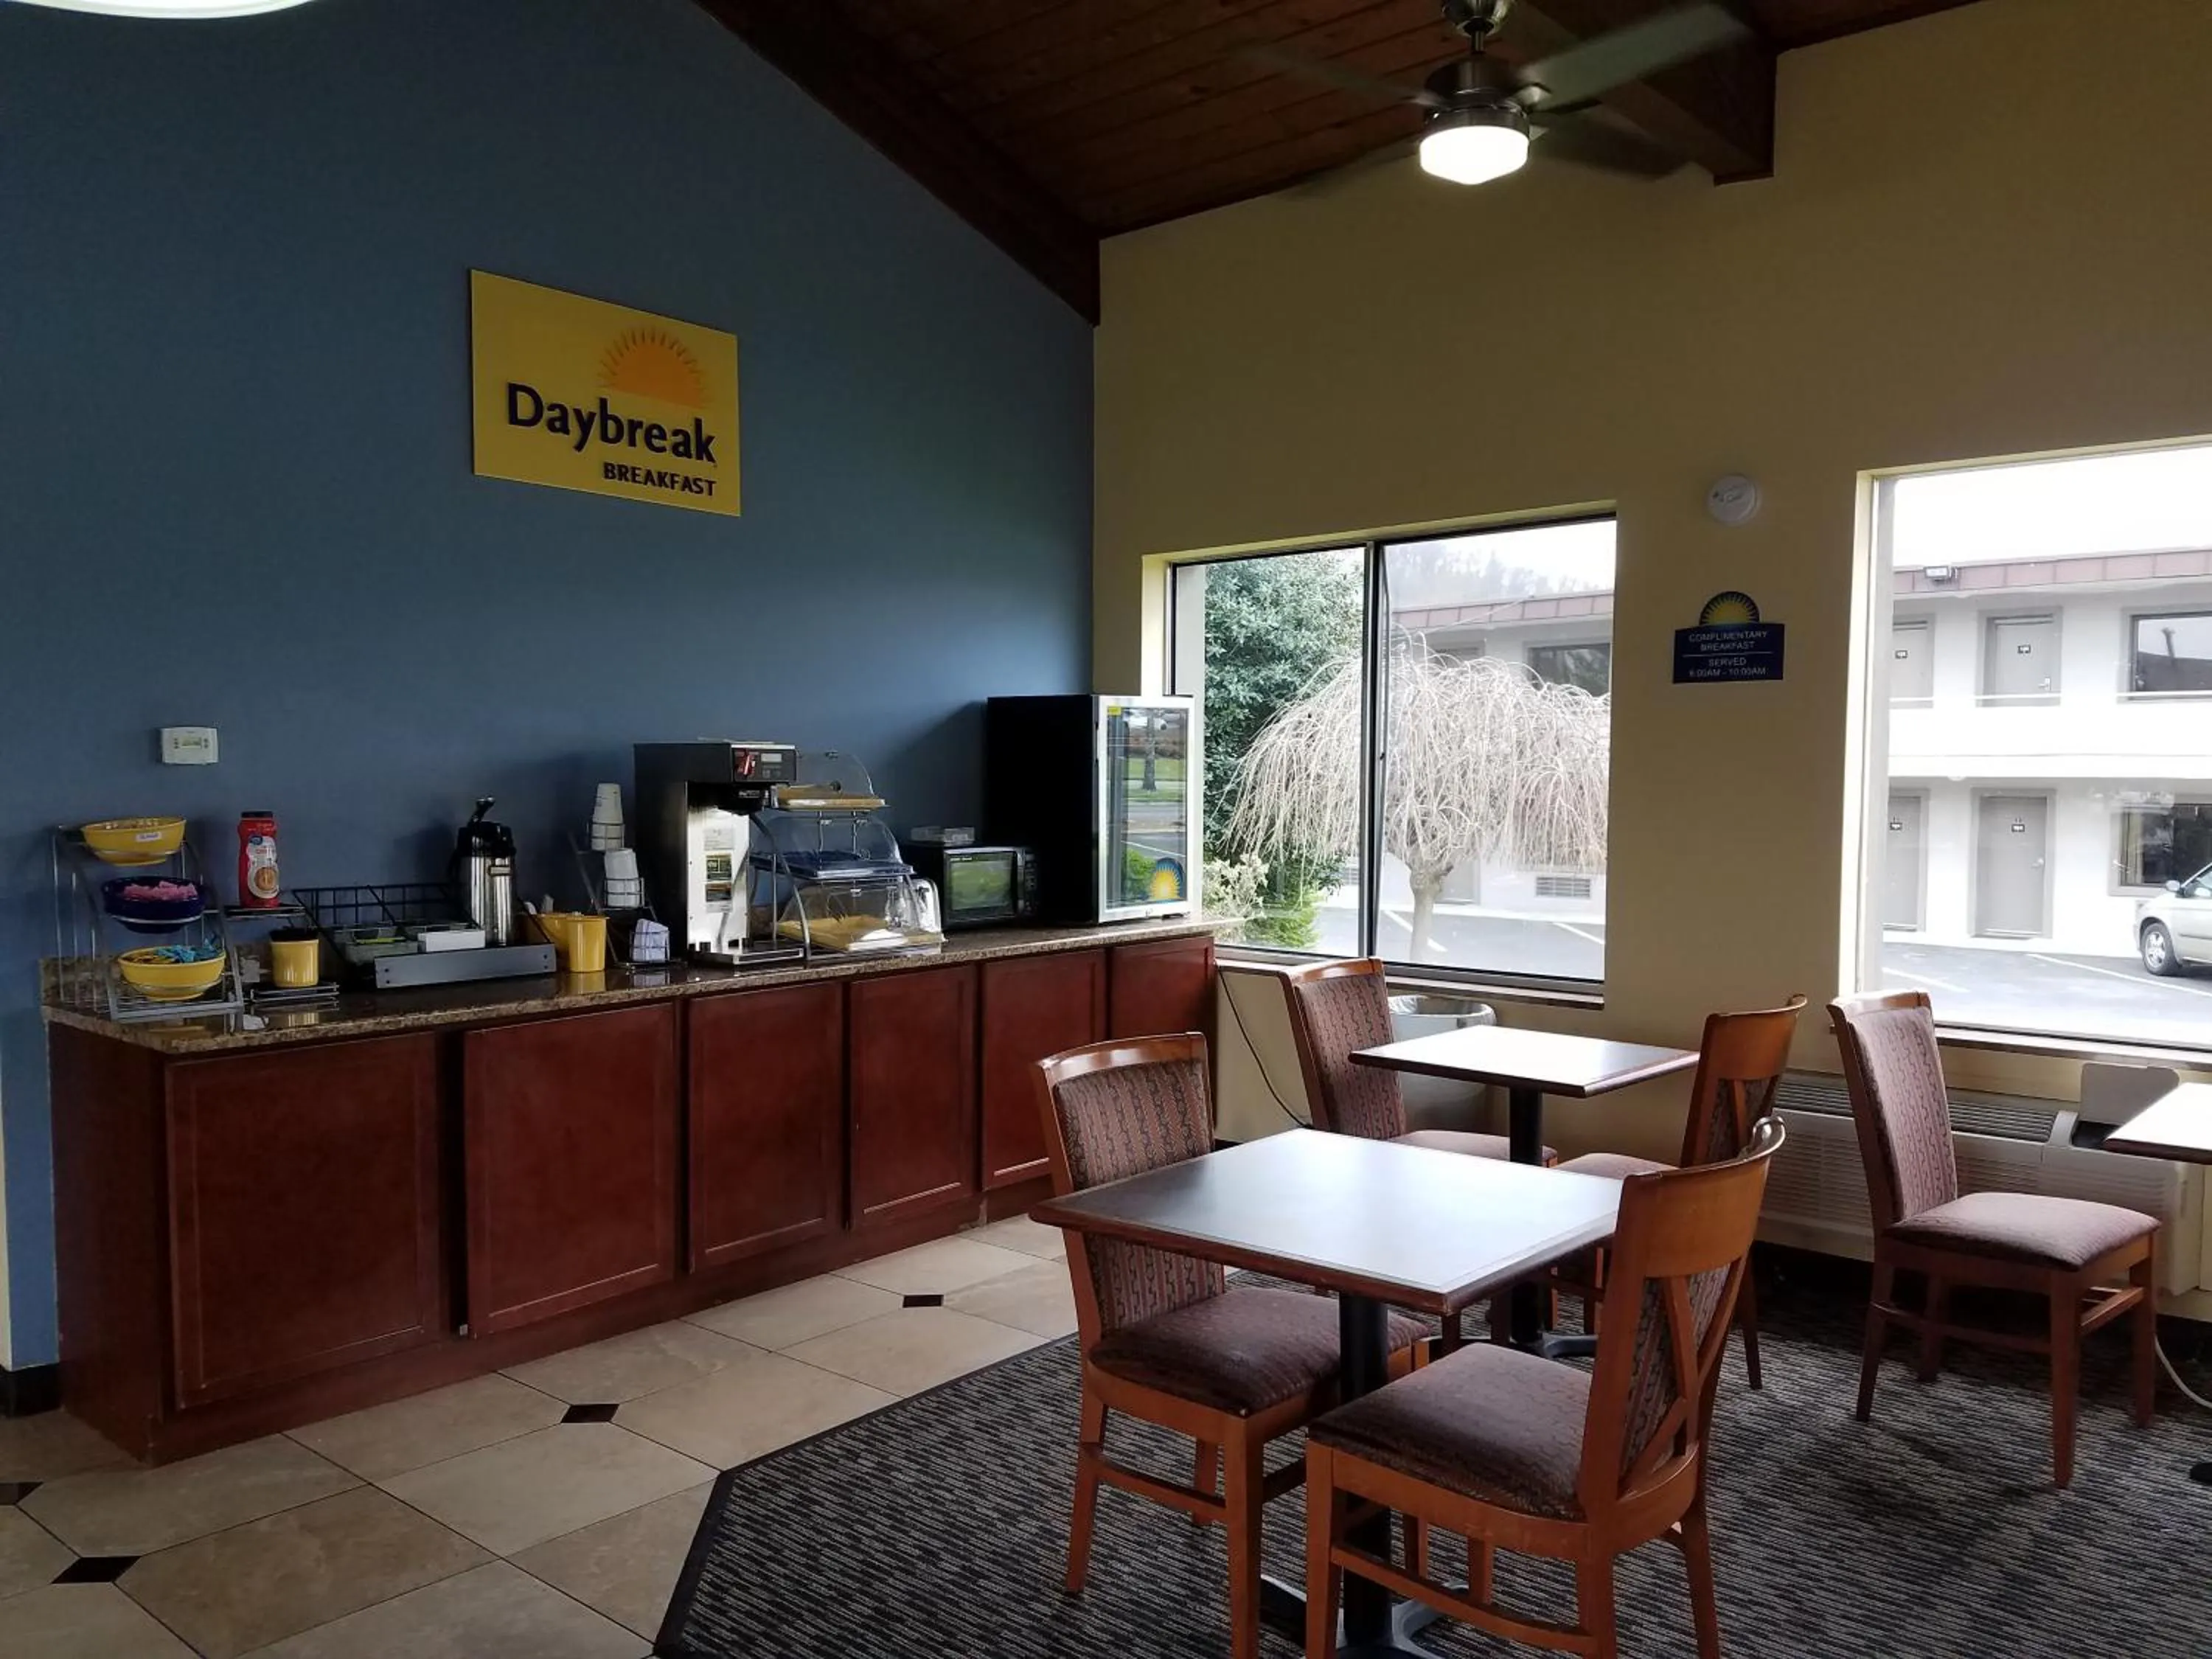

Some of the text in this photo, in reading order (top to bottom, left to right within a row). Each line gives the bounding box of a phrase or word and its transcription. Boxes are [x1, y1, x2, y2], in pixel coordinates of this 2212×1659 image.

[507, 382, 717, 464] Daybreak
[602, 462, 717, 496] BREAKFAST
[1688, 630, 1767, 642] COMPLIMENTARY
[1700, 640, 1756, 651] BREAKFAST
[1708, 656, 1747, 667] SERVED
